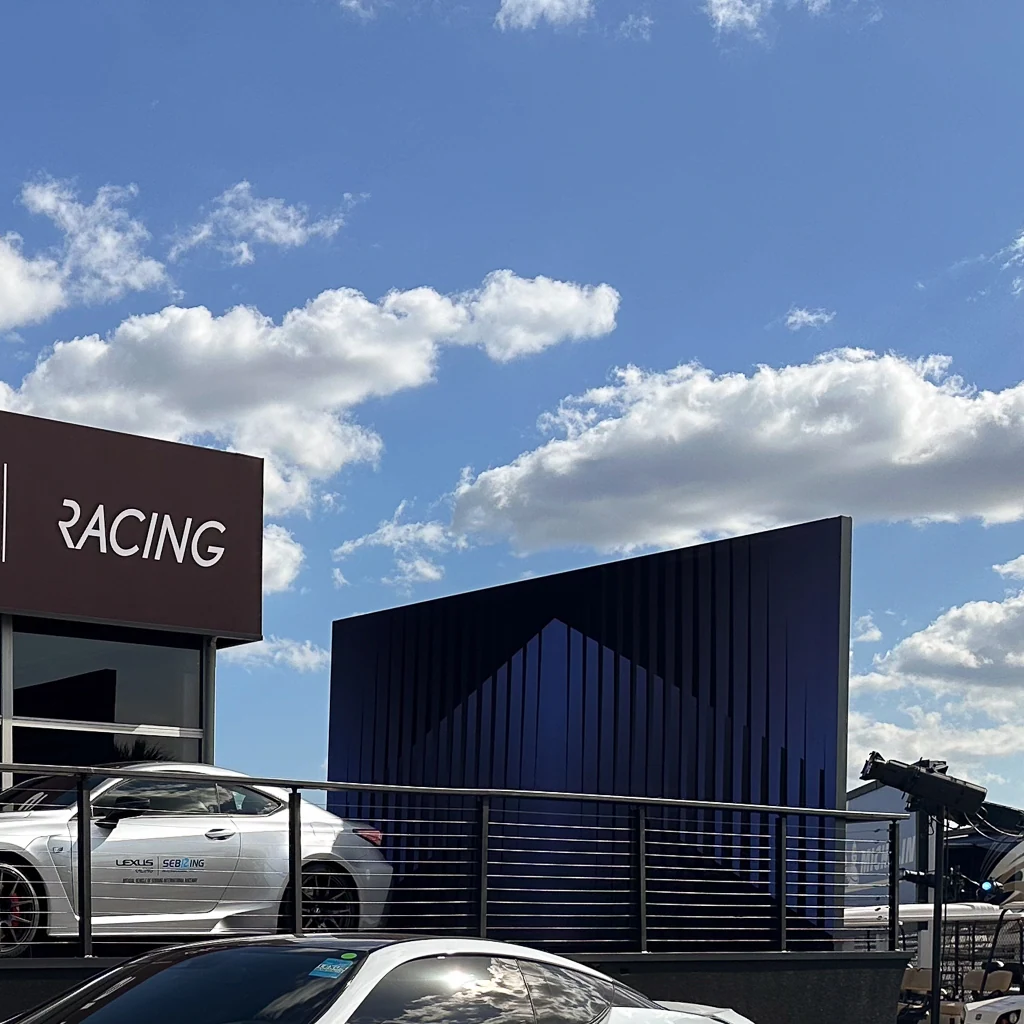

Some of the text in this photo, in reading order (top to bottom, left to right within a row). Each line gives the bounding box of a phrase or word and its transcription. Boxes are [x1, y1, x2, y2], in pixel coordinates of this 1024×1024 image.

[58, 498, 227, 569] RACING
[115, 859, 154, 867] LEXUS
[860, 836, 917, 874] MICHIN
